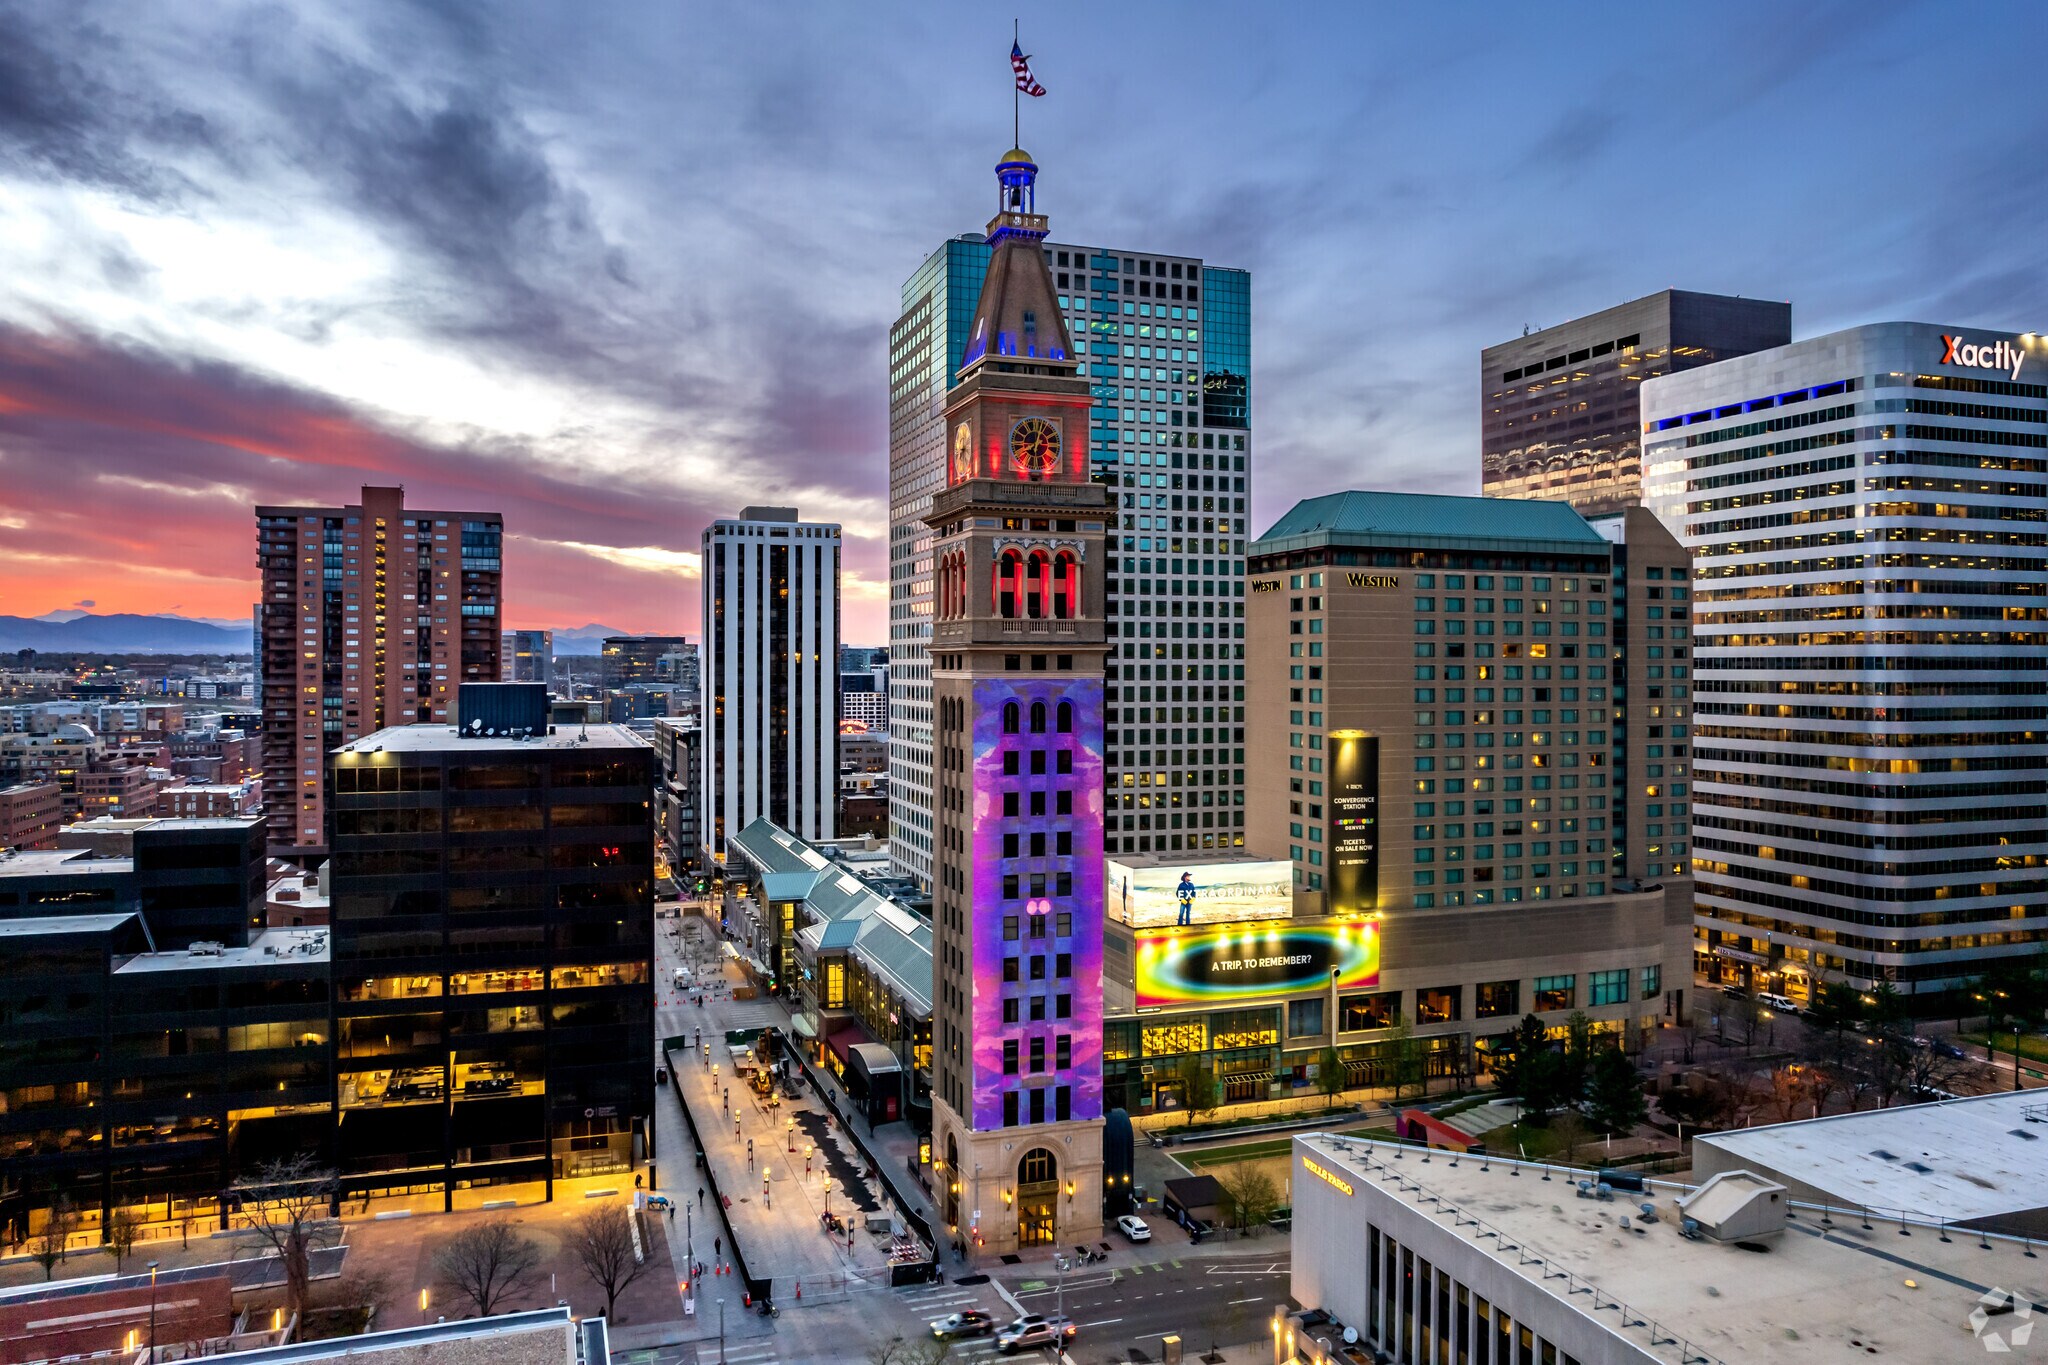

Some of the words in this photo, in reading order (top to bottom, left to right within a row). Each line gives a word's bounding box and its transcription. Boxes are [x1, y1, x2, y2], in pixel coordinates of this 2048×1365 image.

[1941, 334, 2025, 380] Xactly
[1346, 572, 1399, 588] WESTIN
[1178, 885, 1280, 900] EXTRAORDINARY
[1212, 962, 1220, 972] A
[1221, 960, 1243, 971] TRIP,
[1244, 959, 1258, 969] TO
[1259, 954, 1312, 968] REMEMBER?
[1302, 1156, 1327, 1180] WELLS
[1328, 1172, 1353, 1196] FARGO
